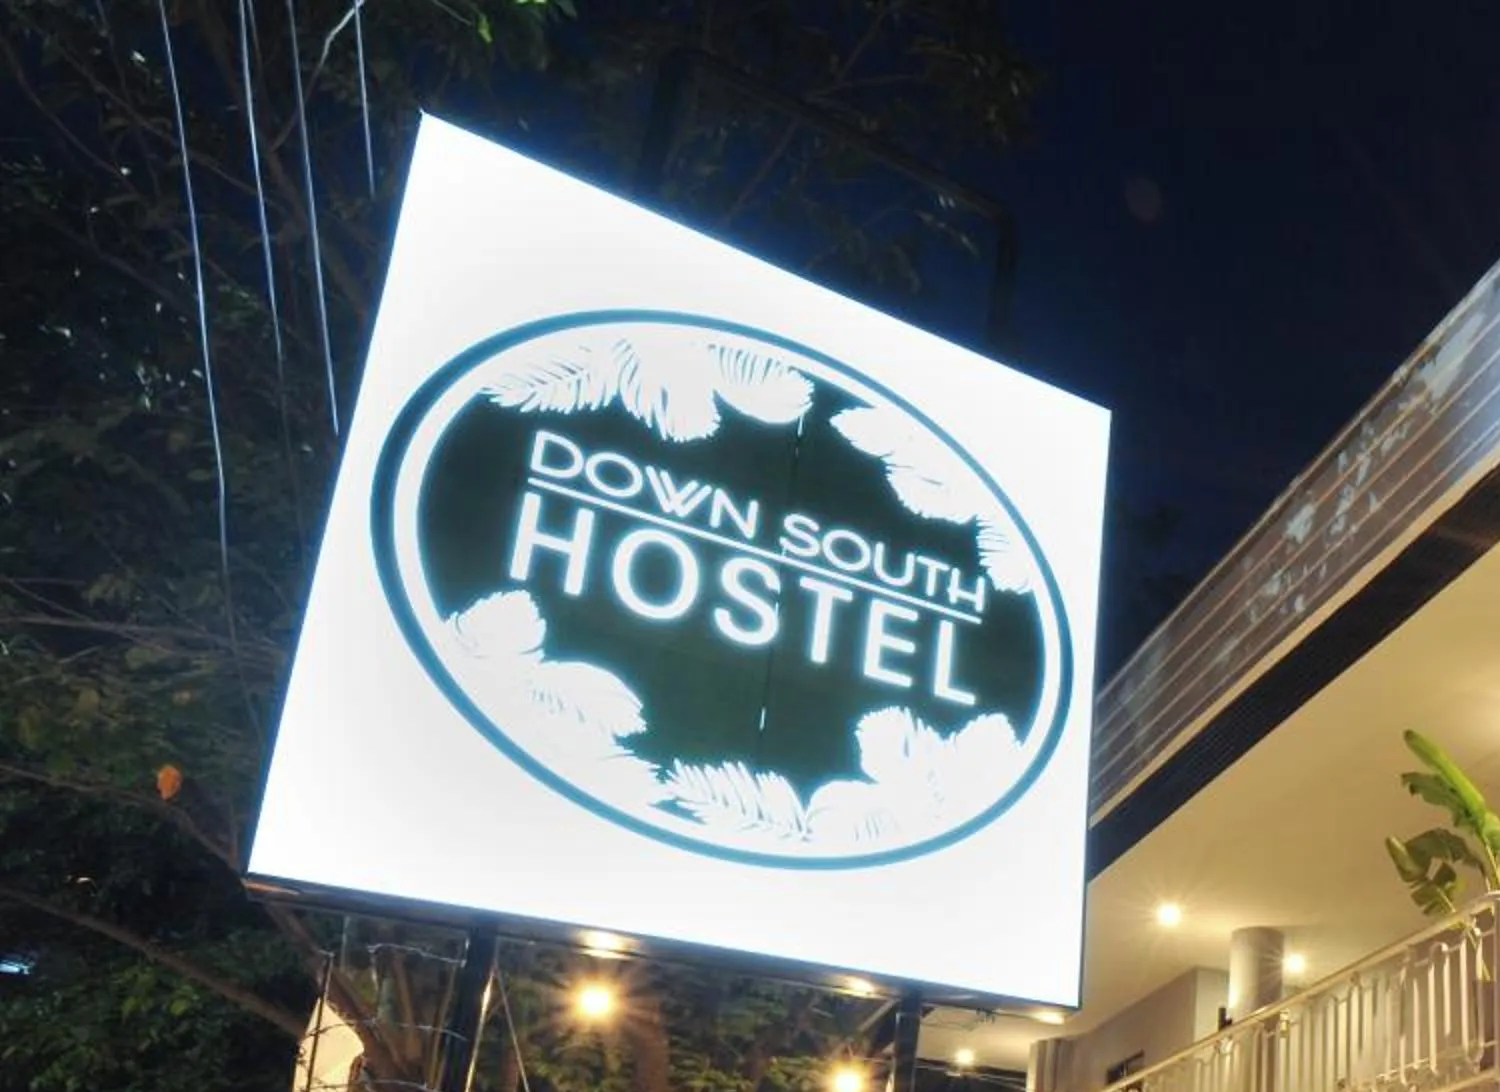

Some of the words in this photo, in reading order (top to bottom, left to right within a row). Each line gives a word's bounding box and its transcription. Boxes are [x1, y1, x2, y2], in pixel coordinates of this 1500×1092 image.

[509, 491, 977, 706] HOSTEL
[529, 429, 758, 539] DOWN
[779, 512, 985, 613] SOUTH
